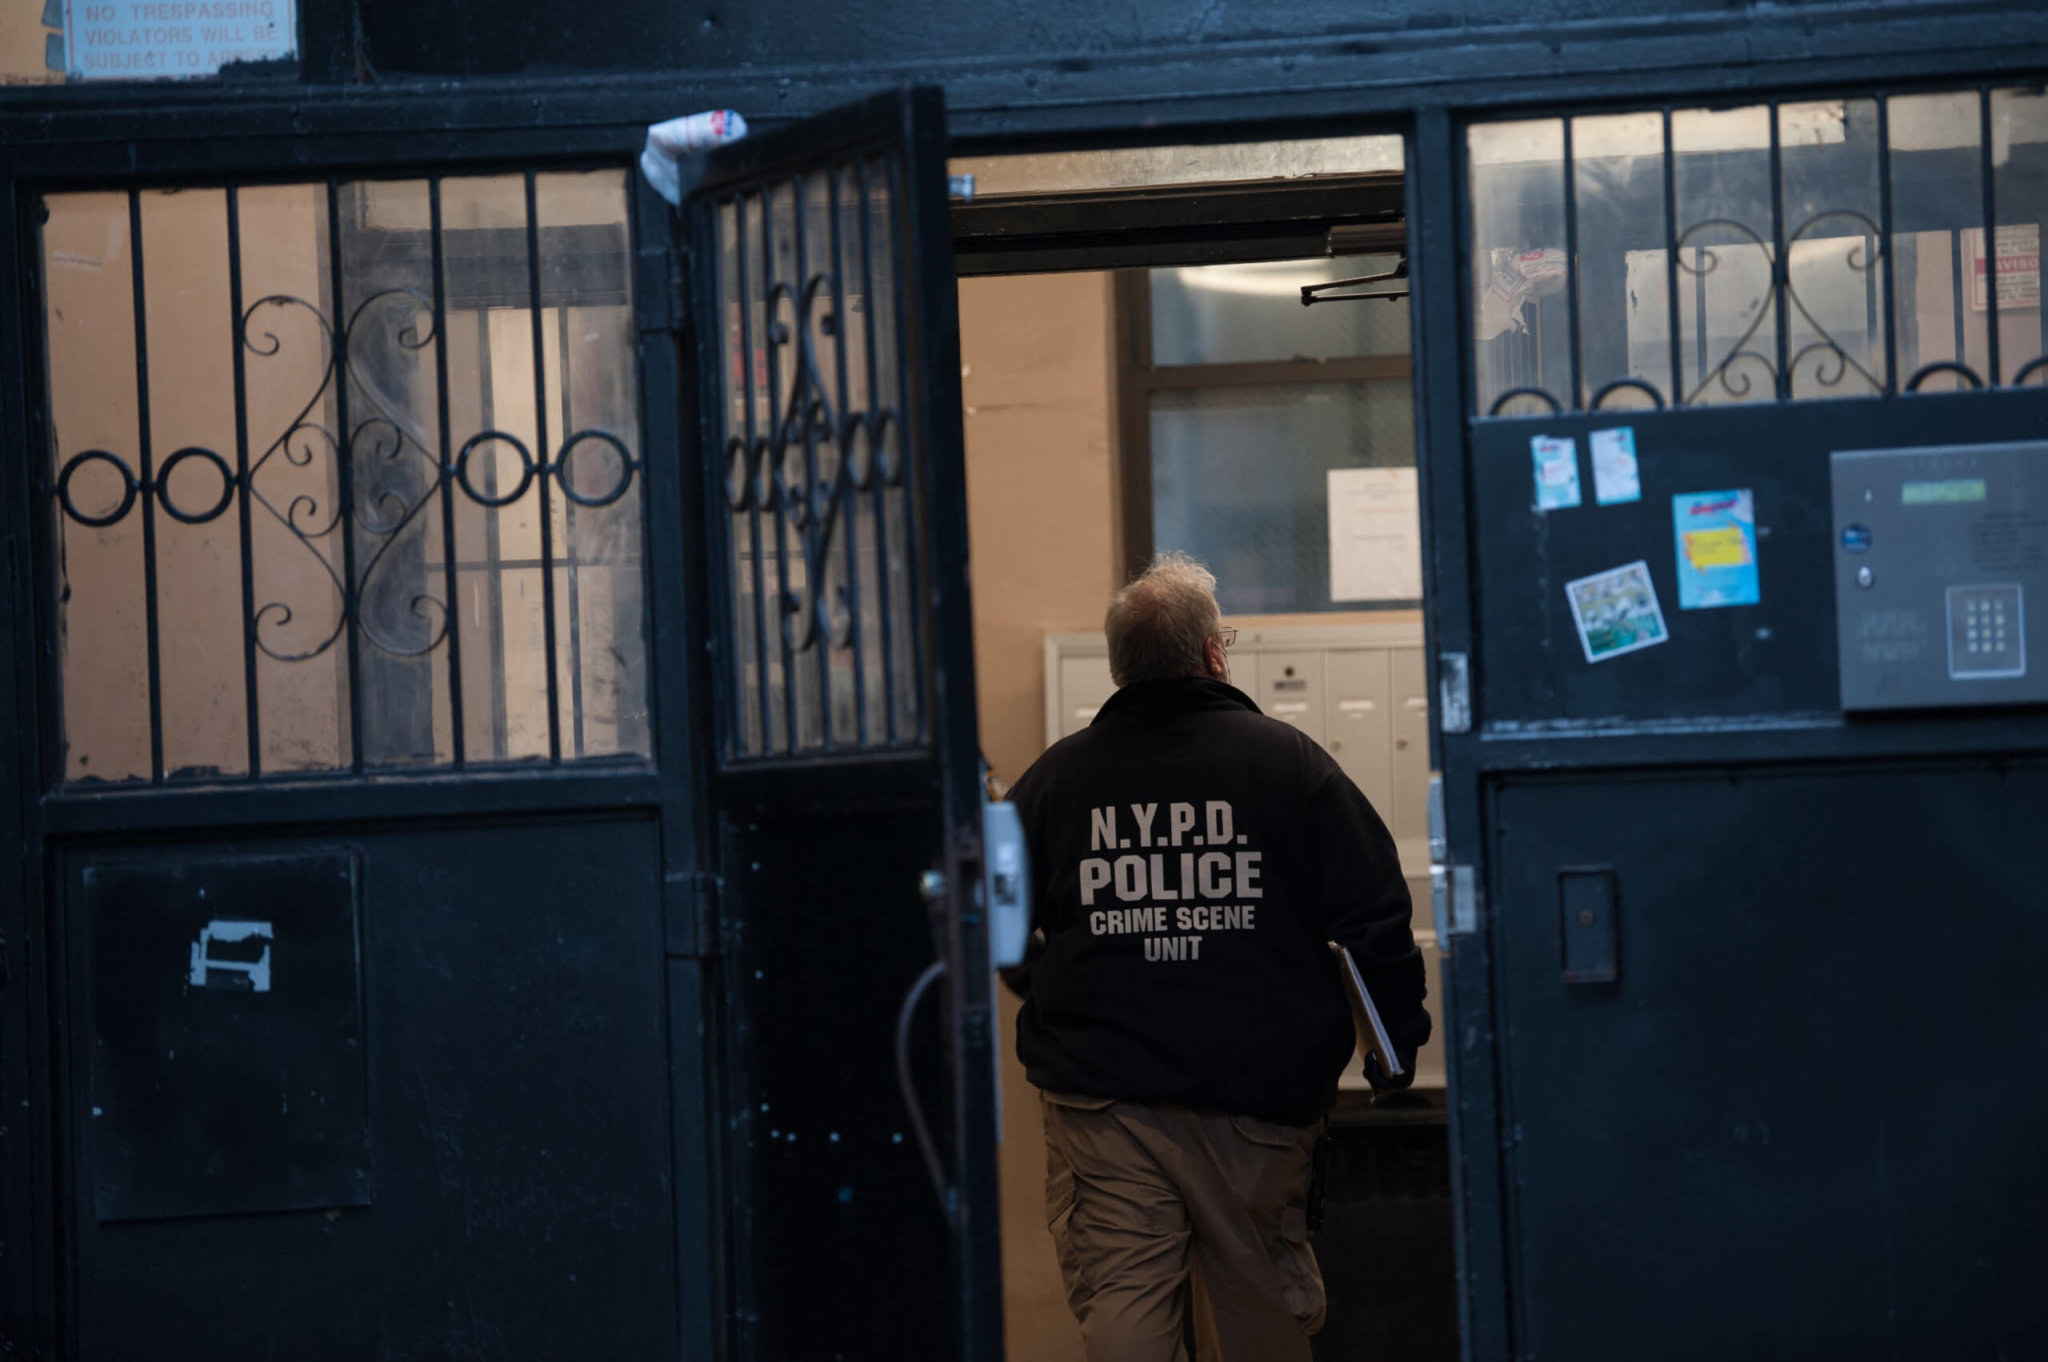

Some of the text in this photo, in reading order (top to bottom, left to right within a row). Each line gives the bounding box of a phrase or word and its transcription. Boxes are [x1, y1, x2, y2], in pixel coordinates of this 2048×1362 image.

[86, 0, 275, 22] NO TRESPASSING
[85, 25, 278, 45] VIOLATORS WILL BE
[84, 50, 166, 70] SUBJECT
[174, 49, 199, 67] TO
[1090, 800, 1248, 851] N.Y.P.D.
[1079, 851, 1263, 906] POLICE
[1089, 905, 1256, 936] CRIME SCENE
[1144, 936, 1203, 962] UNIT
